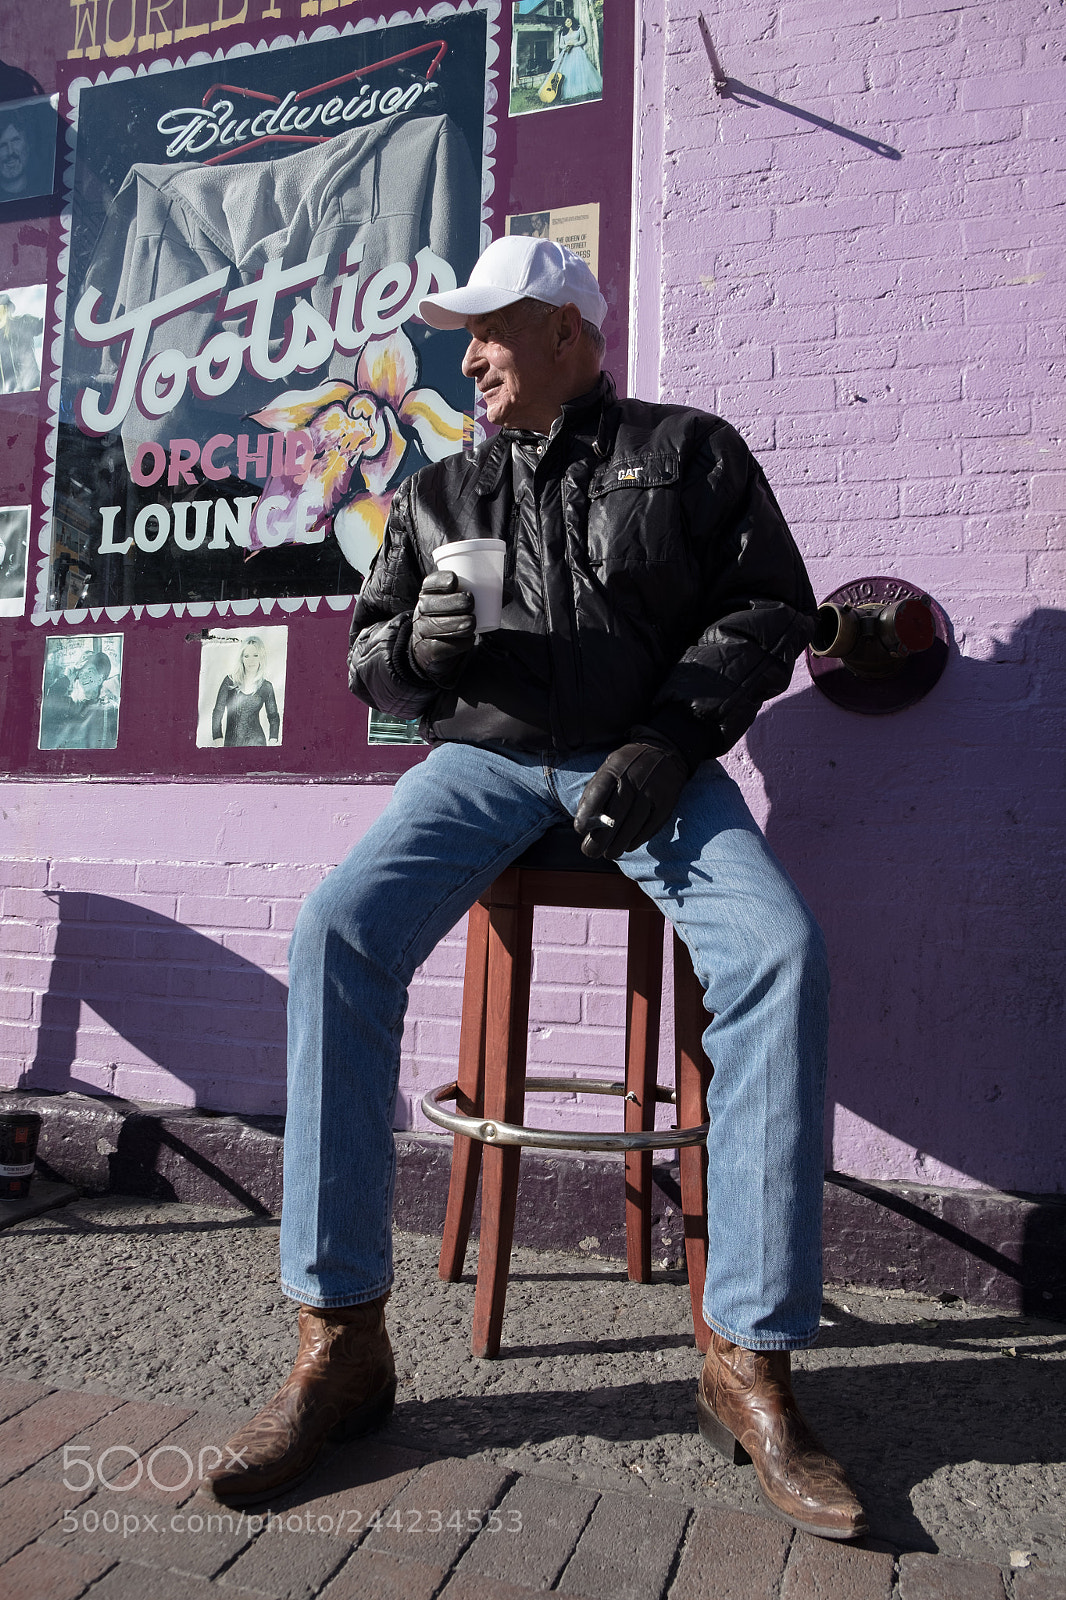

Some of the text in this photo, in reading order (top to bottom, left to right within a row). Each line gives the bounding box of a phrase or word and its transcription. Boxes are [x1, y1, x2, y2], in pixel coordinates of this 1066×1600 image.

[157, 82, 438, 157] Budweiser
[74, 244, 458, 434] Tootsies
[131, 431, 313, 487] ORCHID
[617, 467, 643, 481] CAT
[98, 496, 326, 555] LOUNGE
